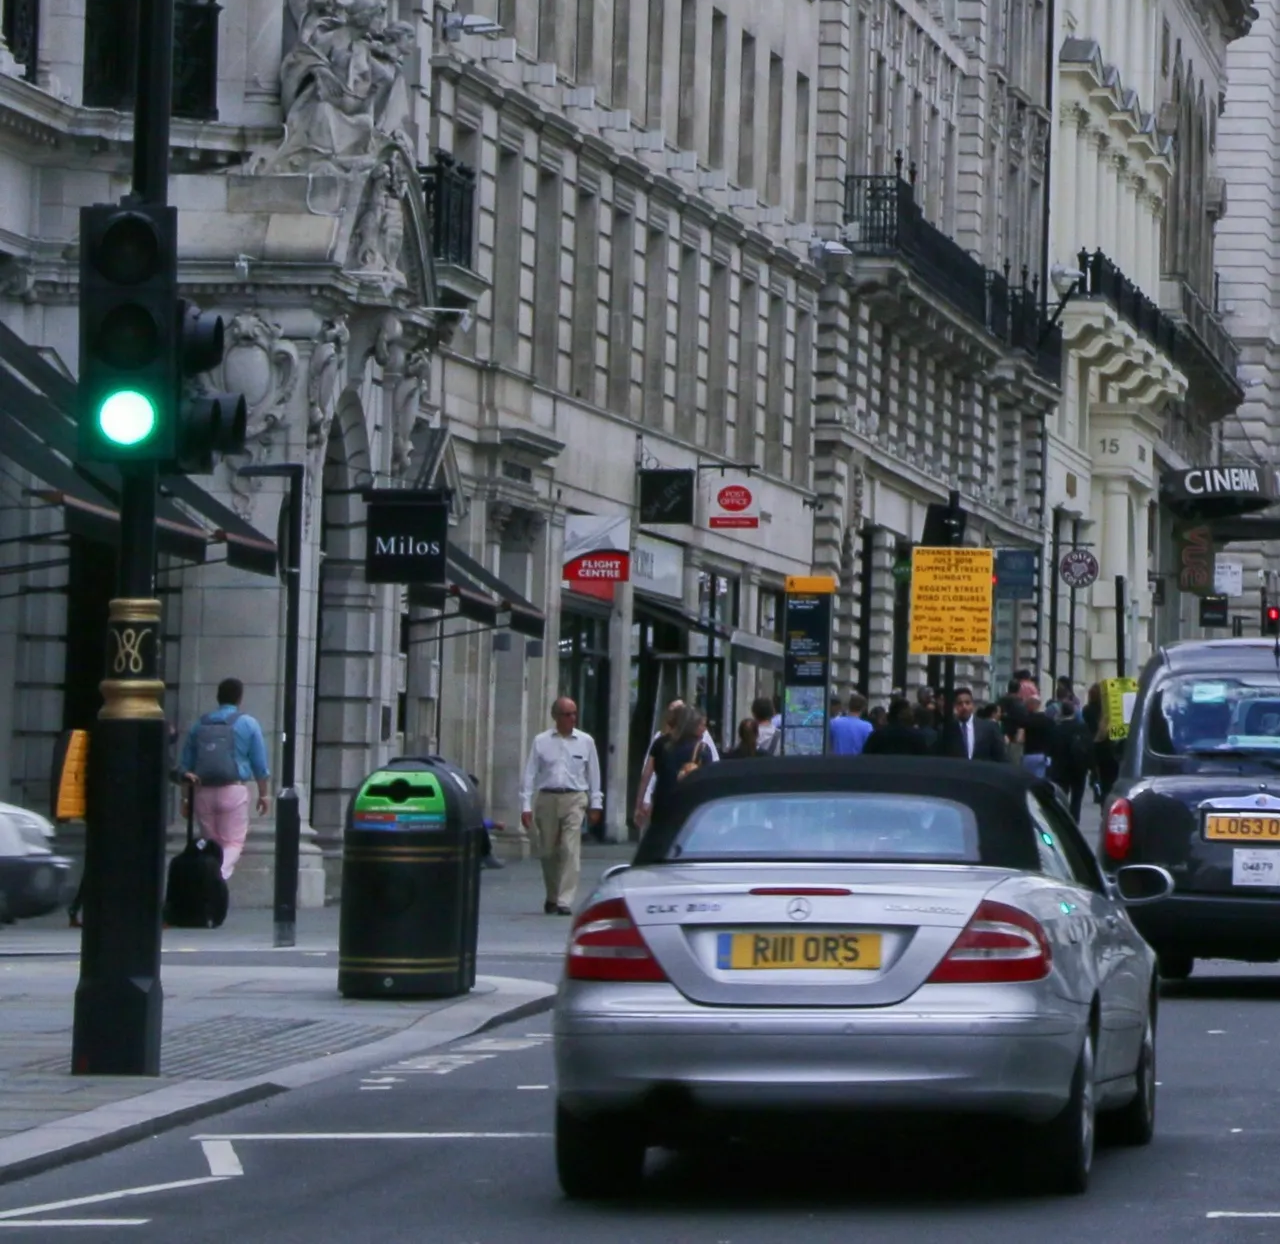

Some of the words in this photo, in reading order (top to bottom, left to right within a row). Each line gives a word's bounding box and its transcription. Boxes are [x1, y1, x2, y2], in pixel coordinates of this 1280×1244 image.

[1099, 438, 1120, 455] 15
[1184, 467, 1260, 495] CINEMA
[725, 489, 746, 498] POST
[720, 497, 748, 506] OFFICE
[375, 536, 440, 555] Milos
[1067, 552, 1091, 564] COSTA
[581, 560, 621, 570] FLIGHT
[915, 565, 951, 573] SUMMER
[954, 566, 989, 574] STREETS
[578, 569, 620, 579] CENTRE
[933, 574, 972, 582] SUNDAYS
[1064, 571, 1093, 586] COFFEE
[918, 585, 952, 593] REGENT
[954, 585, 984, 593] STREET
[942, 594, 986, 603] CLOSURES
[1215, 819, 1264, 835] LO63
[647, 904, 678, 914] CLK
